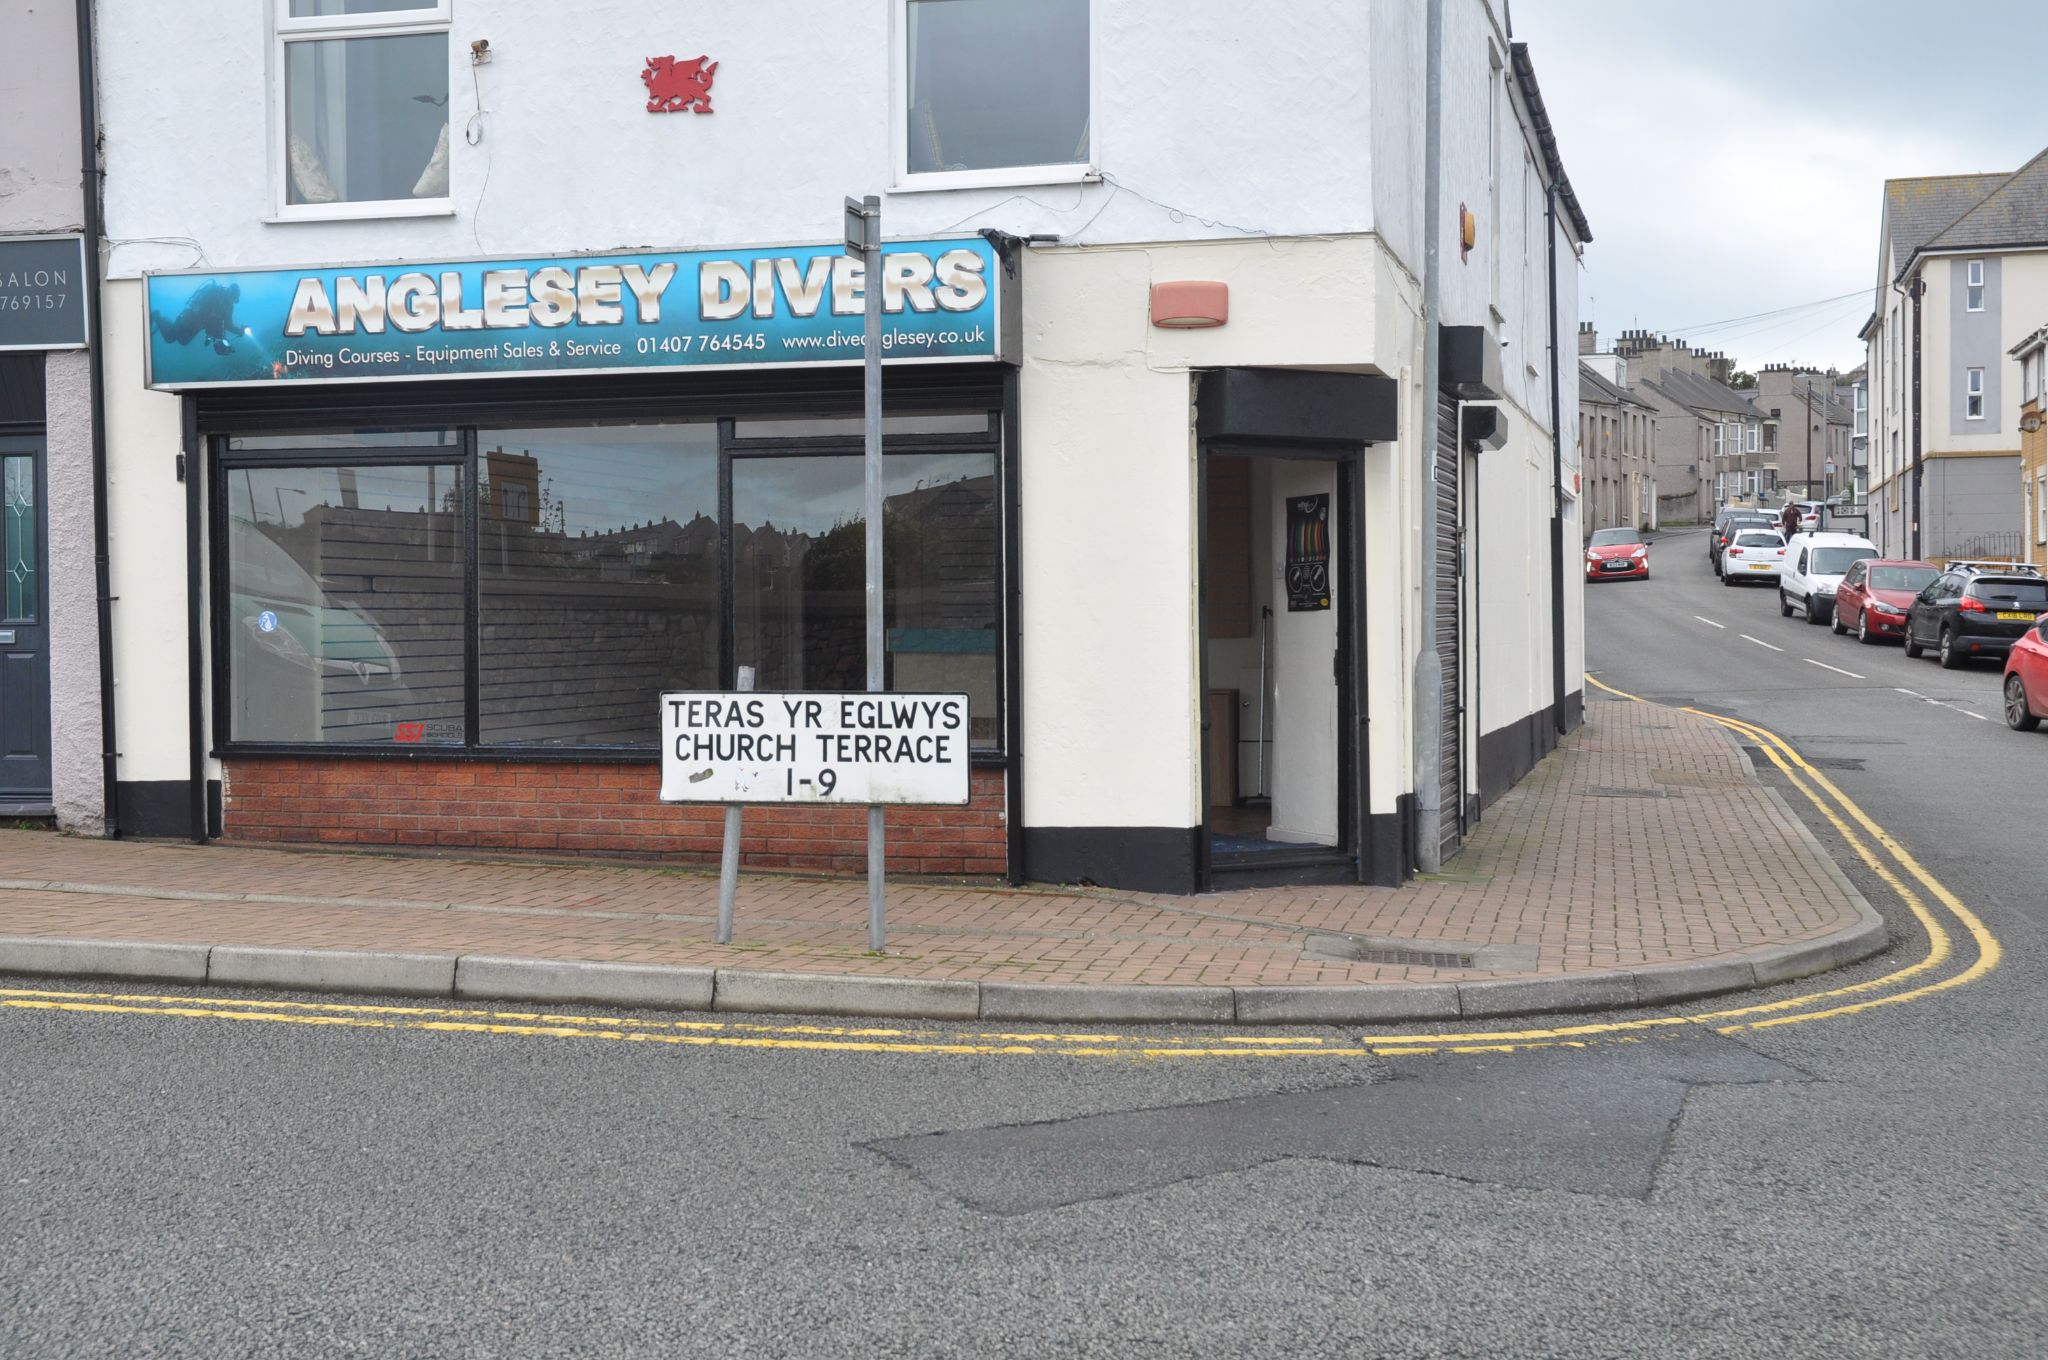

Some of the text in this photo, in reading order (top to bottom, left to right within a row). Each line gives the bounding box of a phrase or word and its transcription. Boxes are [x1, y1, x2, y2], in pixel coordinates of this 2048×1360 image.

[0, 270, 66, 288] ALON
[284, 249, 988, 337] ANGLESEY DIVERS
[0, 294, 66, 311] 769157
[286, 349, 334, 369] Diving
[338, 348, 400, 364] Courses
[416, 343, 498, 365] Equipment
[504, 341, 544, 359] Sales
[549, 341, 561, 356] &
[566, 340, 621, 356] Service
[637, 336, 692, 354] 01407
[698, 333, 766, 351] 764545
[782, 325, 985, 350] www.diveglesey.co.uk
[426, 723, 463, 732] SCUBA
[668, 700, 961, 730] TERAS YR EGLWYS
[675, 733, 952, 763] CHURCH TERRACE
[787, 768, 837, 796] 1-9
